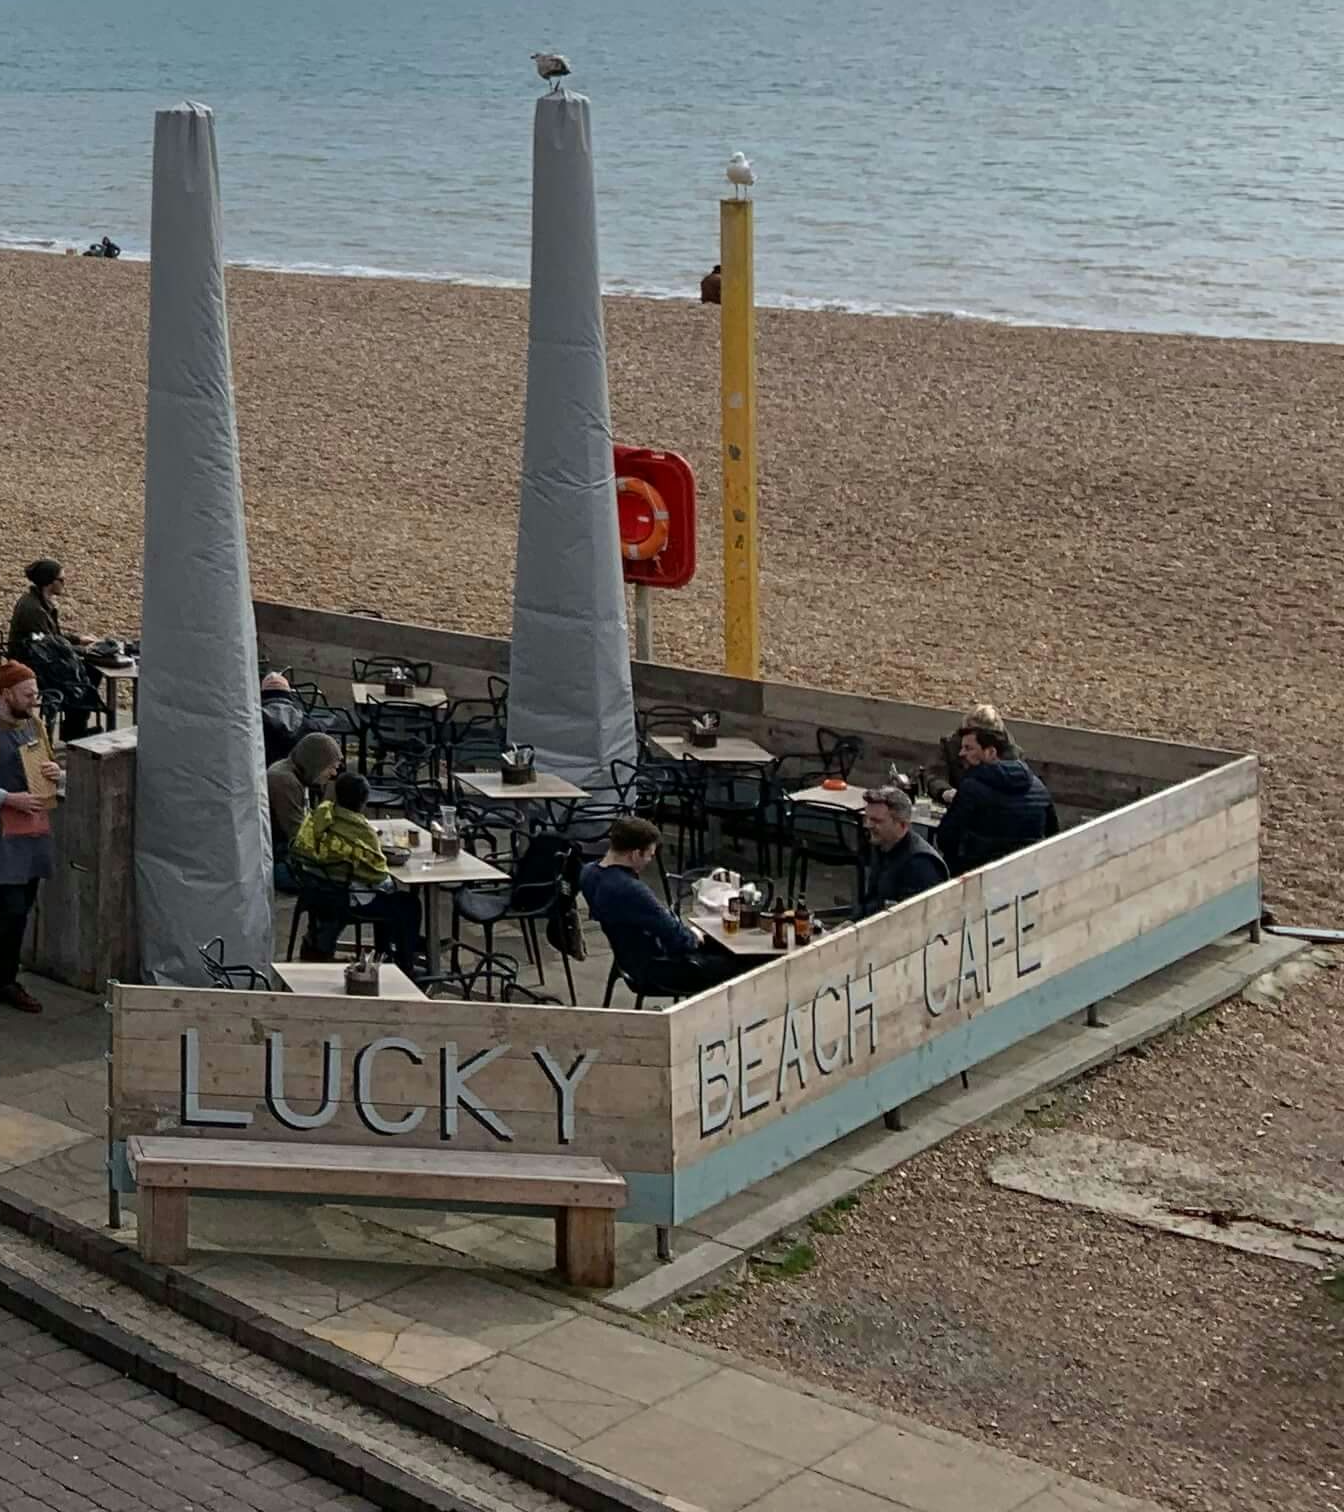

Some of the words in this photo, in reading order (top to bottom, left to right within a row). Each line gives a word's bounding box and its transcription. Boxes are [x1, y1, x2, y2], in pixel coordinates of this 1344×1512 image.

[181, 1027, 600, 1144] LUCKY
[697, 958, 879, 1139] BEACH
[923, 885, 1043, 1017] CAFE
